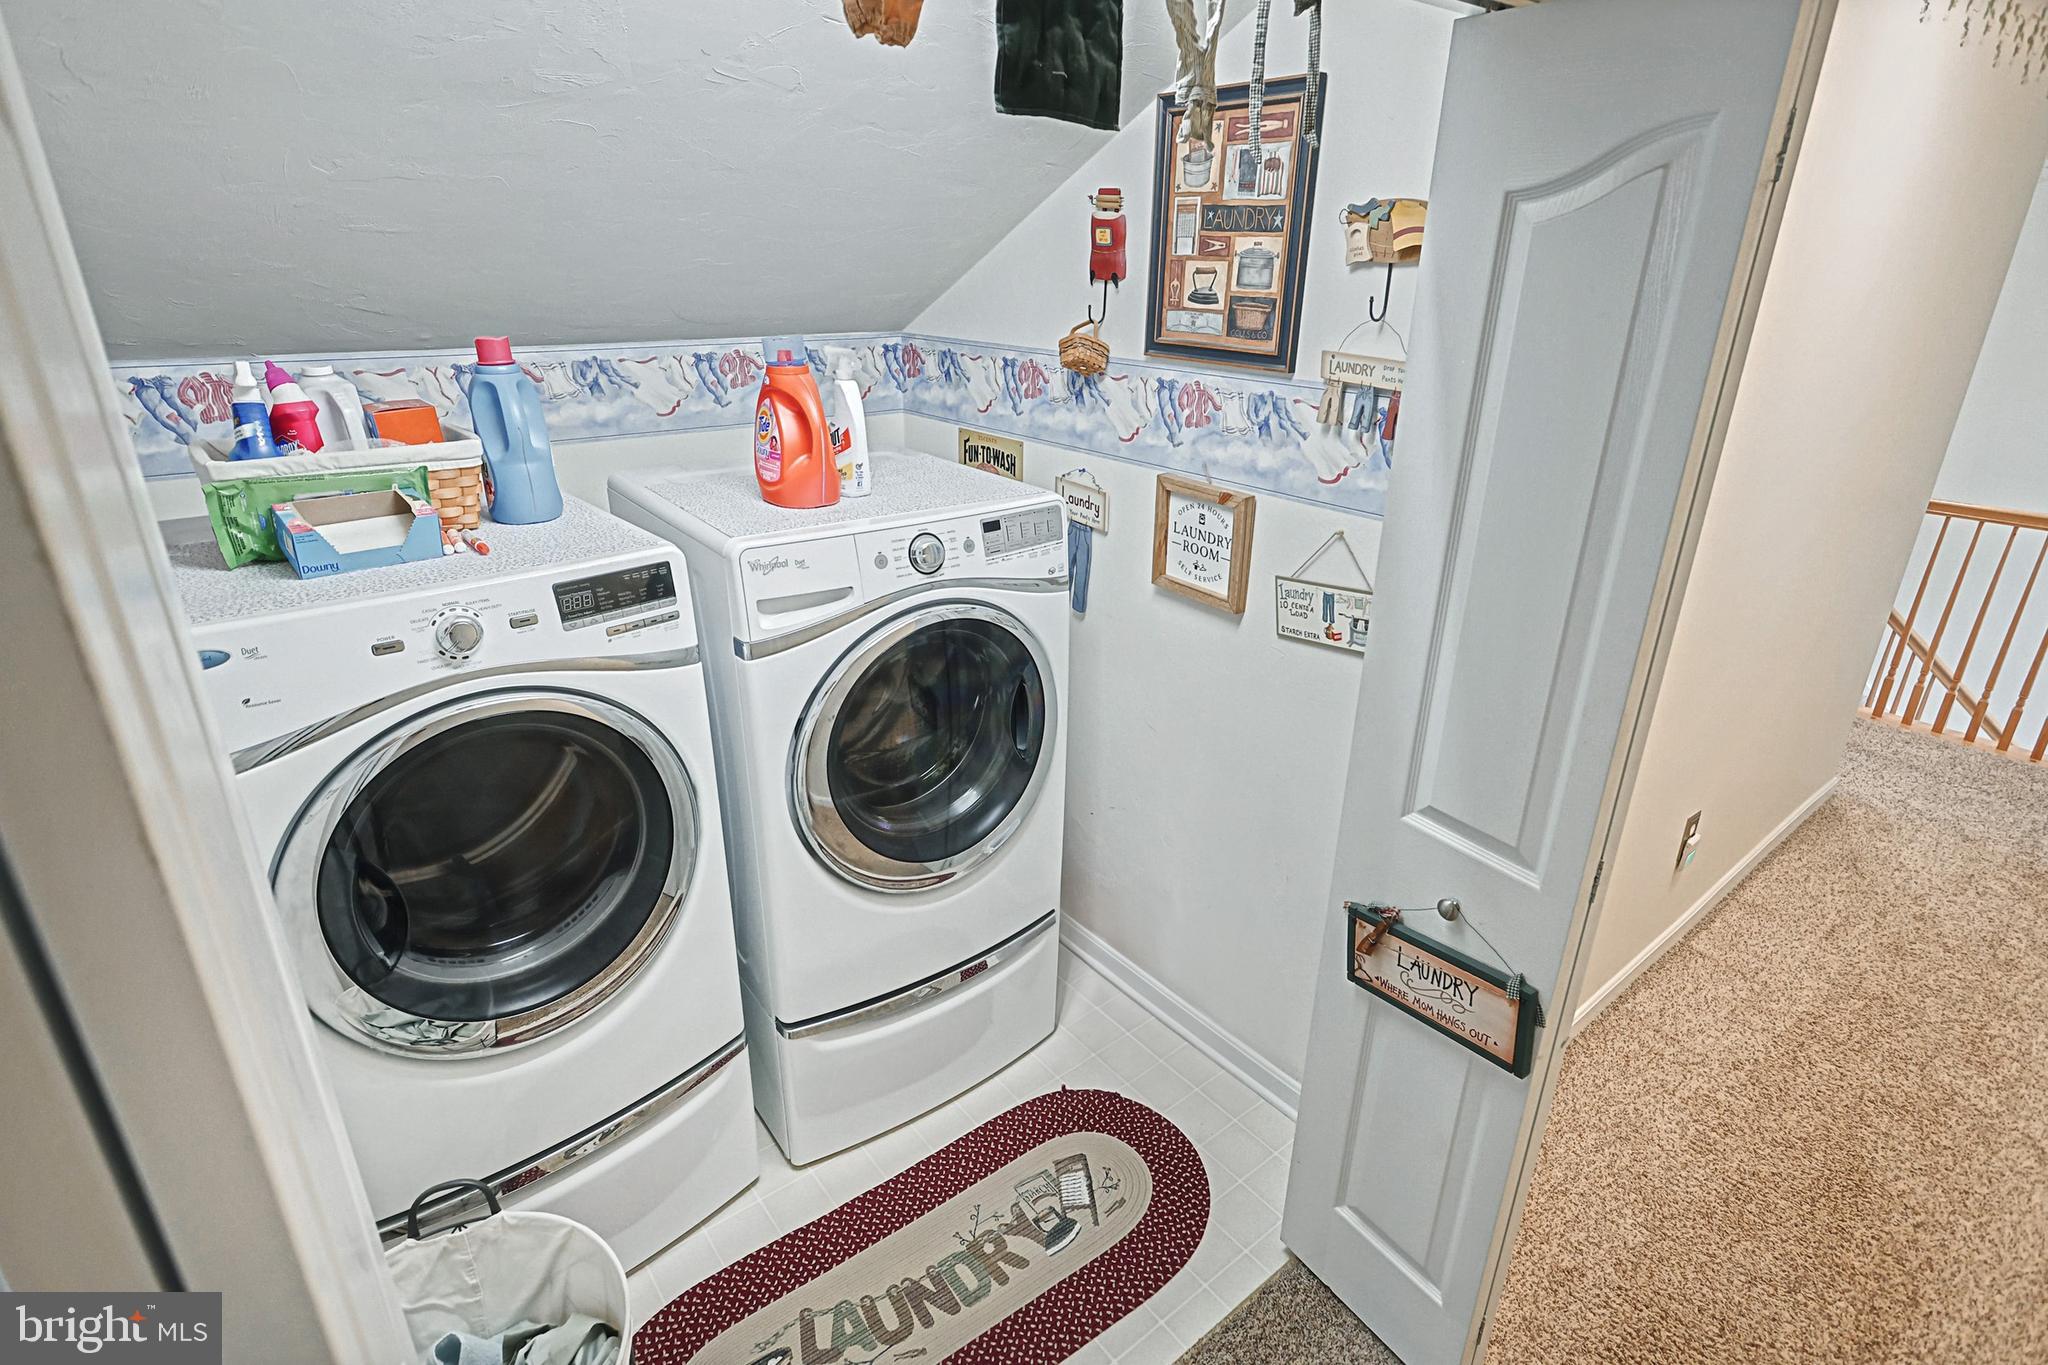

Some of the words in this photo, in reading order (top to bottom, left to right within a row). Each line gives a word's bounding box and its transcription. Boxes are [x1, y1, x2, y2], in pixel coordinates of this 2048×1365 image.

[1203, 207, 1274, 230] LAUNDRY
[1329, 359, 1376, 377] LAUNDRY
[1177, 502, 1195, 516] OPEN
[1197, 502, 1205, 510] 24
[1207, 505, 1229, 530] HOURS
[1173, 521, 1232, 550] LAUNDRY
[1183, 539, 1220, 562] ROOM
[301, 562, 340, 575] Downy
[747, 556, 789, 576] Whirlpool
[1177, 560, 1192, 576] SELF
[1194, 573, 1223, 583] SERVICE
[1278, 583, 1314, 606] Laundry
[1279, 601, 1289, 609] 10
[1289, 608, 1309, 619] LOAD
[1281, 625, 1303, 636] STARCH
[1303, 630, 1321, 641] EXTRA
[240, 646, 259, 656] Duet
[1396, 946, 1480, 1007] LAUNDRY
[1379, 976, 1409, 1002] WHERE
[1412, 995, 1435, 1016] MOM
[1436, 1009, 1466, 1032] HANGS
[1469, 1028, 1492, 1046] OUT
[799, 1200, 1052, 1365] LAUNDRY
